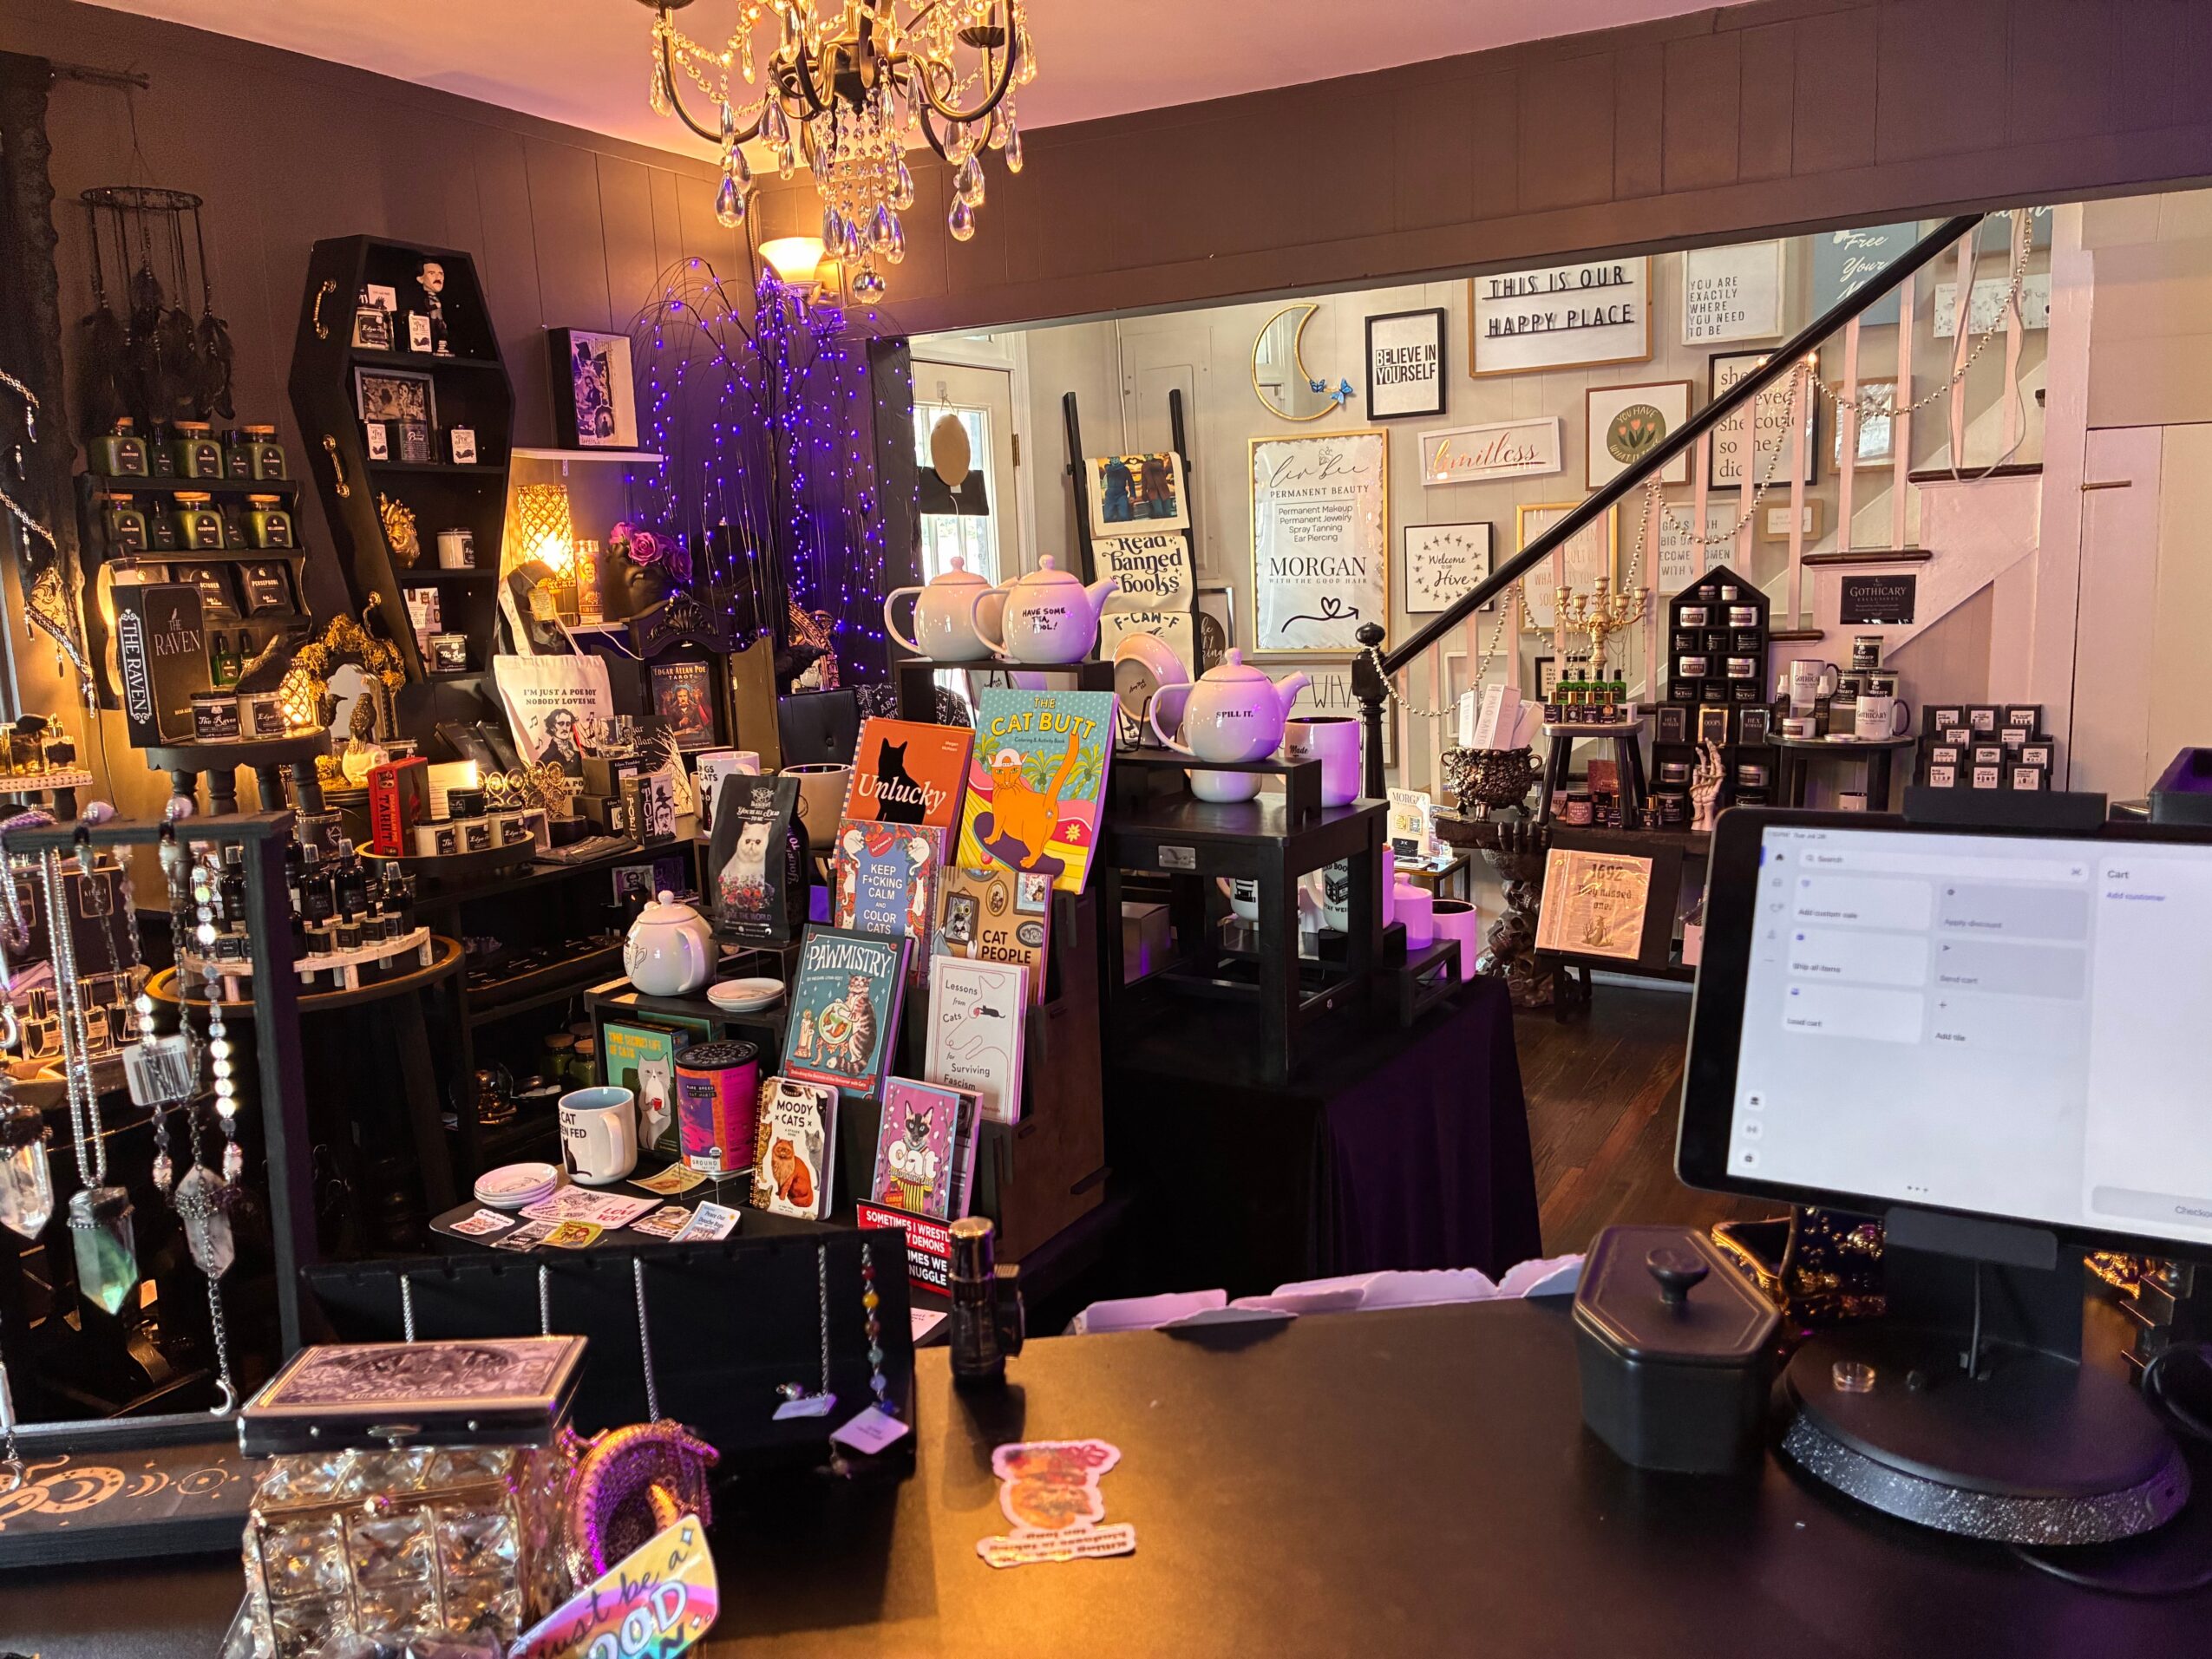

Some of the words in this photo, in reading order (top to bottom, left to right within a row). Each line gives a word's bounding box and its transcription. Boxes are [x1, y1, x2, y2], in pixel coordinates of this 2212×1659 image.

[1844, 233, 1889, 251] Free
[1489, 276, 1535, 297] THIS
[1549, 272, 1566, 291] IS
[1580, 266, 1624, 285] OUR
[1691, 279, 1711, 291] YOU
[1718, 277, 1738, 287] ARE
[1690, 289, 1738, 301] EXACTLY
[1690, 302, 1727, 313] WHERE
[1489, 312, 1554, 335] HAPPY
[1567, 304, 1631, 327] PLACE
[1690, 314, 1712, 325] YOU
[1717, 311, 1745, 323] NEED
[1690, 326, 1702, 337] TO
[1709, 324, 1721, 336] BE
[1376, 346, 1422, 365] BELIEVE
[1425, 344, 1436, 360] IN
[1376, 362, 1436, 384] YOURSELF
[1616, 409, 1632, 422] YOU
[1633, 406, 1658, 417] HAVE
[1433, 432, 1539, 472] limitless
[1719, 441, 1738, 454] so
[1270, 488, 1327, 498] PERMANENT
[1332, 485, 1370, 494] BEAUTY
[1279, 506, 1320, 515] Permanent
[1322, 505, 1353, 514] Makeup
[1279, 515, 1321, 524] Permanent
[1323, 514, 1352, 524] Jewelry
[1289, 526, 1311, 534] Spray
[1312, 525, 1343, 533] Tanning
[1307, 533, 1338, 543] Piercing
[1660, 536, 1676, 545] BIG
[1118, 536, 1167, 555] Read
[1102, 548, 1182, 574] banned
[1429, 553, 1466, 565] Welcome
[1270, 557, 1367, 577] MORGAN
[1662, 565, 1685, 576] WITH
[1113, 573, 1181, 596] books
[1434, 570, 1469, 586] Hive
[1849, 586, 1907, 597] GOTHICARY
[168, 619, 181, 631] THE
[122, 623, 136, 655] THE
[154, 630, 201, 656] RAVEN
[654, 667, 673, 676] EDGAR
[675, 666, 693, 675] ALLAN
[128, 658, 147, 711] RAVEN
[1034, 697, 1057, 709] THE
[199, 716, 212, 725] The
[991, 712, 1033, 737] CAT
[1038, 711, 1097, 740] BUTT
[1289, 745, 1308, 754] Made
[858, 773, 947, 814] Unlucky
[871, 863, 896, 876] KEEP
[1592, 864, 1623, 881] 1692
[2107, 870, 2130, 879] Cart
[868, 887, 895, 900] CALM
[1600, 887, 1632, 899] missed
[2106, 892, 2124, 900] Add
[2125, 893, 2165, 902] customer
[1593, 901, 1613, 911] one.
[863, 910, 896, 924] COLOR
[1944, 918, 1967, 928] Apply
[1968, 919, 2002, 929] discount
[867, 922, 891, 935] CATS
[982, 930, 1008, 945] CAT
[807, 944, 893, 978] PAWMISTRY
[981, 945, 1031, 964] PEOPLE
[1793, 963, 1810, 972] Ship
[946, 980, 978, 996] Lessons
[952, 997, 966, 1007] from
[942, 1011, 962, 1023] Cats
[1809, 1019, 1823, 1028] cart
[946, 1052, 955, 1061] for
[952, 1062, 991, 1077] Surviving
[944, 1074, 976, 1091] Fascism
[776, 1100, 814, 1116] MOODY
[560, 1114, 576, 1125] CAT
[782, 1114, 805, 1127] CATS
[570, 1129, 587, 1139] FED
[888, 1140, 939, 1179] Cat
[697, 1217, 716, 1225] Douche
[866, 1210, 912, 1230] SOMETIMES
[913, 1224, 917, 1233] I
[913, 1236, 946, 1253] DEMONS
[932, 1258, 947, 1272] WE
[618, 1571, 660, 1604] be
[669, 1550, 689, 1571] a
